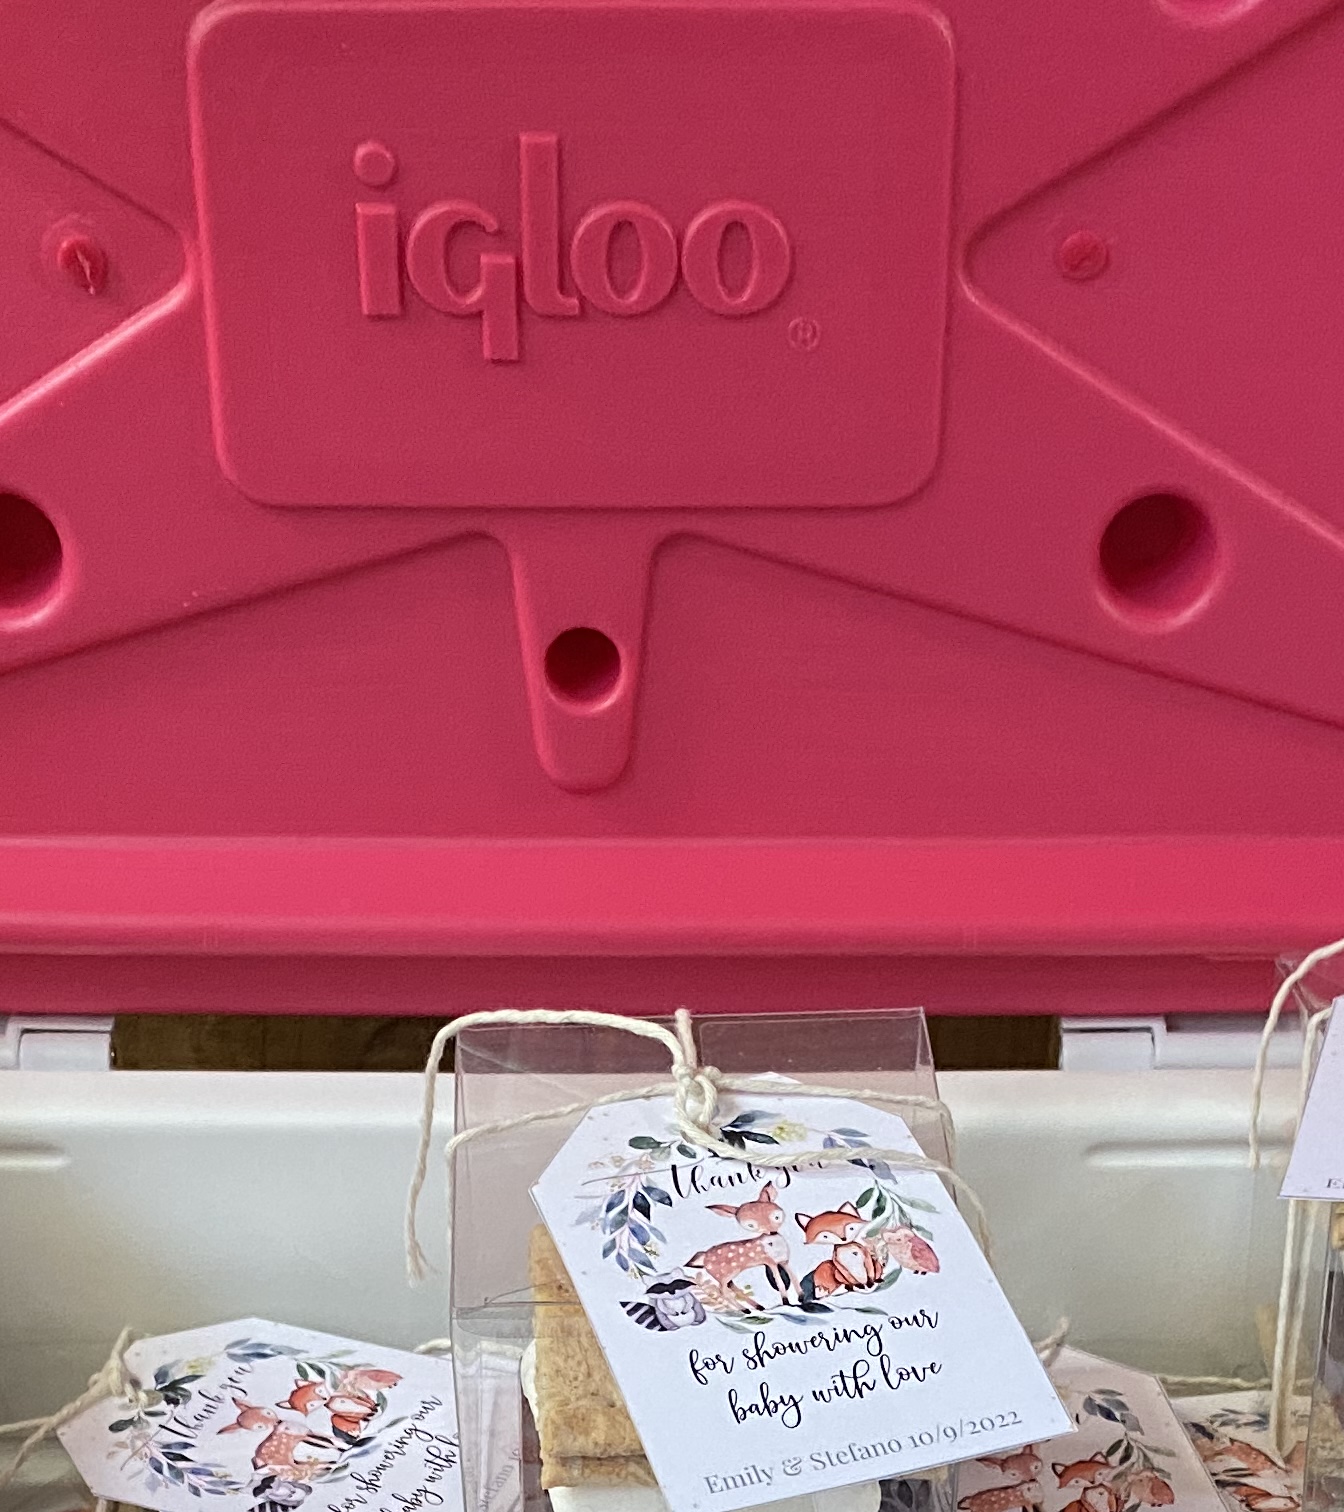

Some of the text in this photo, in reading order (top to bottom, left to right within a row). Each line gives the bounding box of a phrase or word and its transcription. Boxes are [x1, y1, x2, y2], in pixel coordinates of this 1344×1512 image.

[355, 131, 794, 361] igloo
[687, 1309, 939, 1386] for showering our
[157, 1365, 254, 1439] thank you
[728, 1353, 943, 1429] baby with love
[350, 1422, 434, 1495] showering
[411, 1395, 443, 1422] our
[424, 1445, 458, 1484] with
[703, 1409, 1024, 1496] Emily & Stefano 10/9/2022
